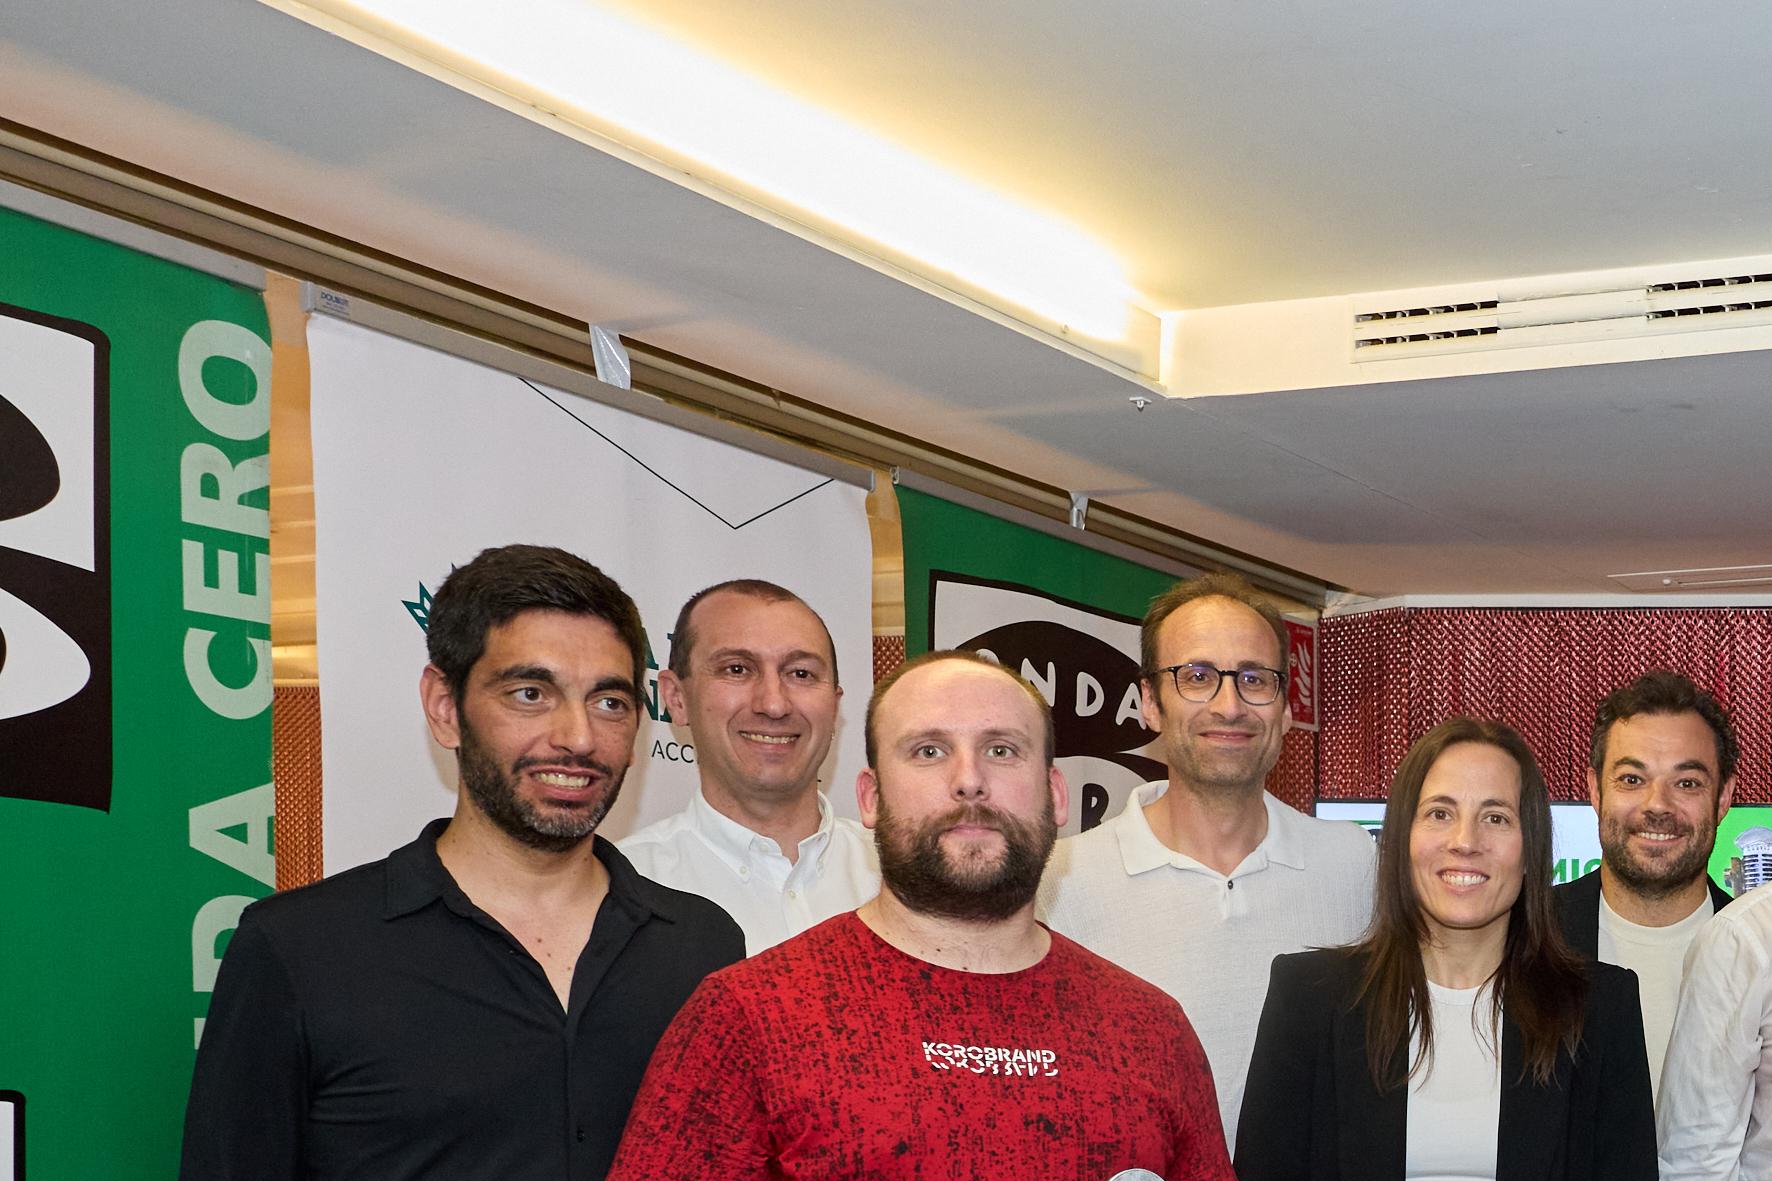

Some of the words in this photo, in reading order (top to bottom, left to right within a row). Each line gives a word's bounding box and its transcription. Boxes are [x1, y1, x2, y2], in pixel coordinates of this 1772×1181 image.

[178, 319, 274, 720] CERO
[976, 648, 1147, 731] NDA
[922, 1041, 1057, 1064] KOROBRAND
